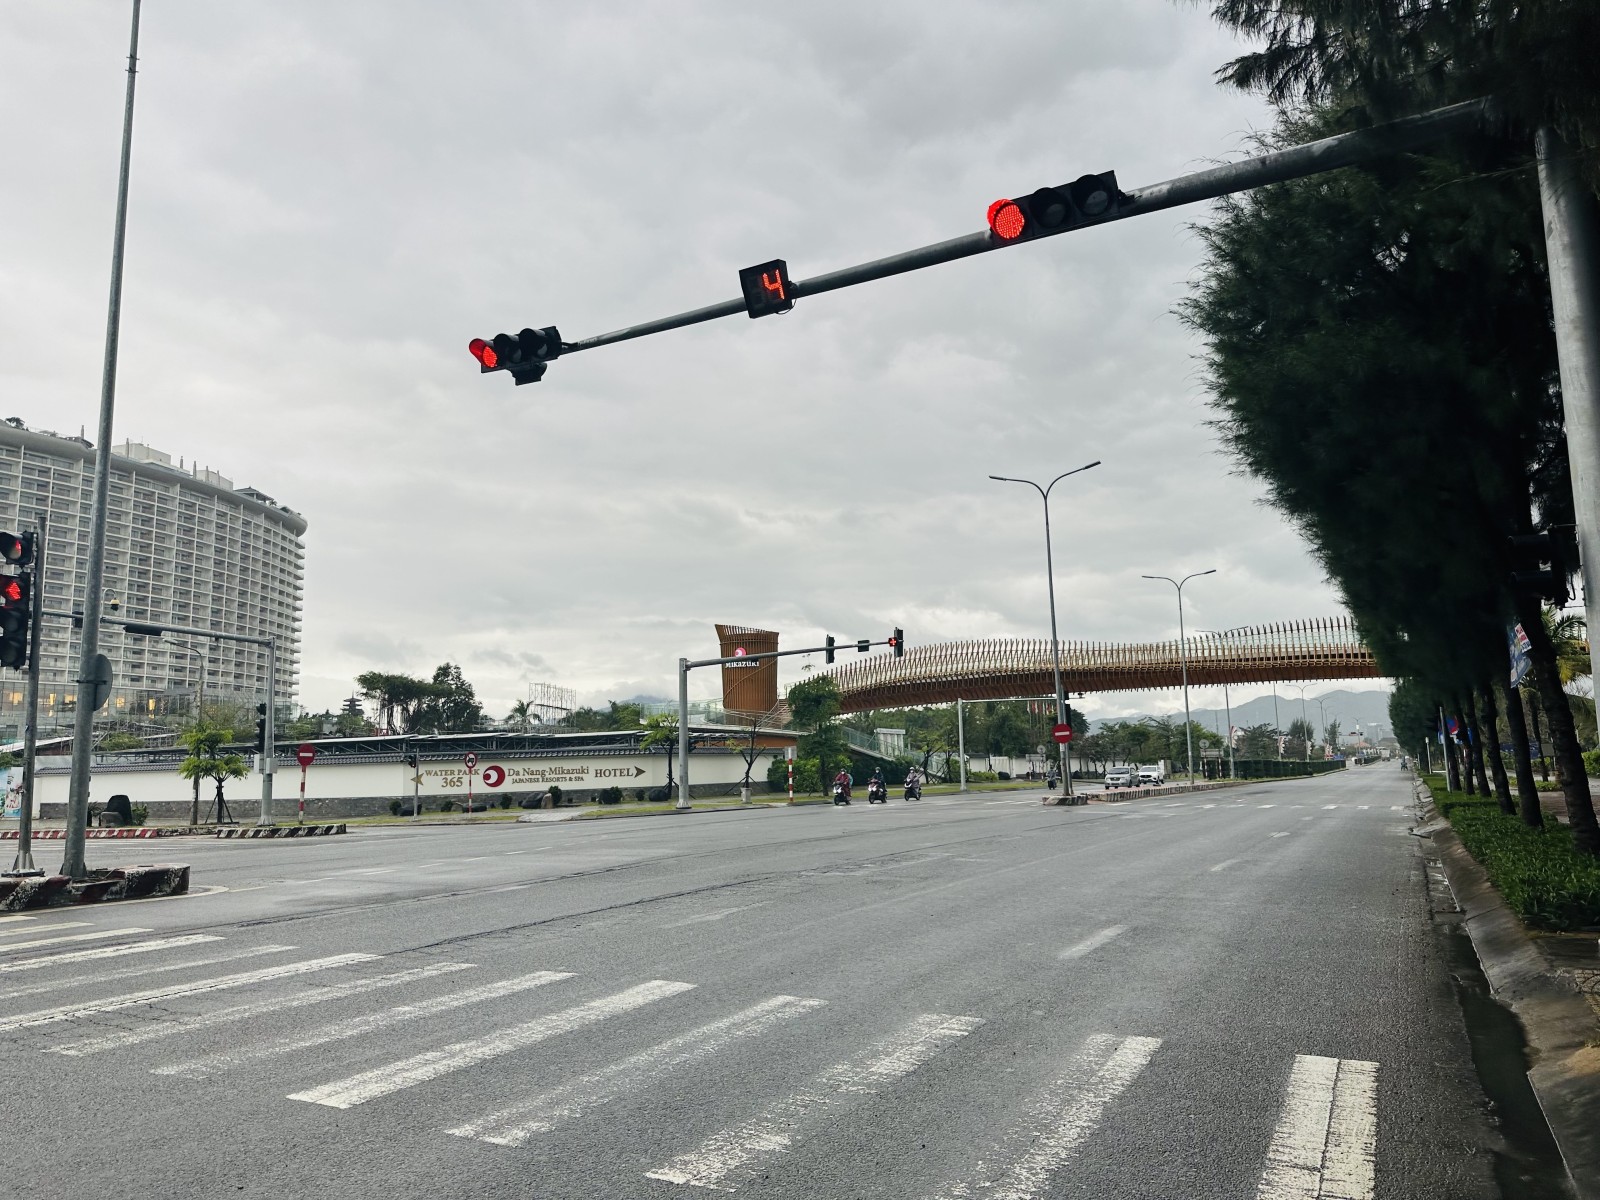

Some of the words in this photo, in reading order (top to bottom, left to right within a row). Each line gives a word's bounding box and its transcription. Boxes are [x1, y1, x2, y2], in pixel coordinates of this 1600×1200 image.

[762, 269, 785, 300] 4
[425, 769, 455, 777] WATER
[507, 768, 520, 777] Da
[594, 768, 633, 778] HOTEL
[441, 776, 464, 788] 365
